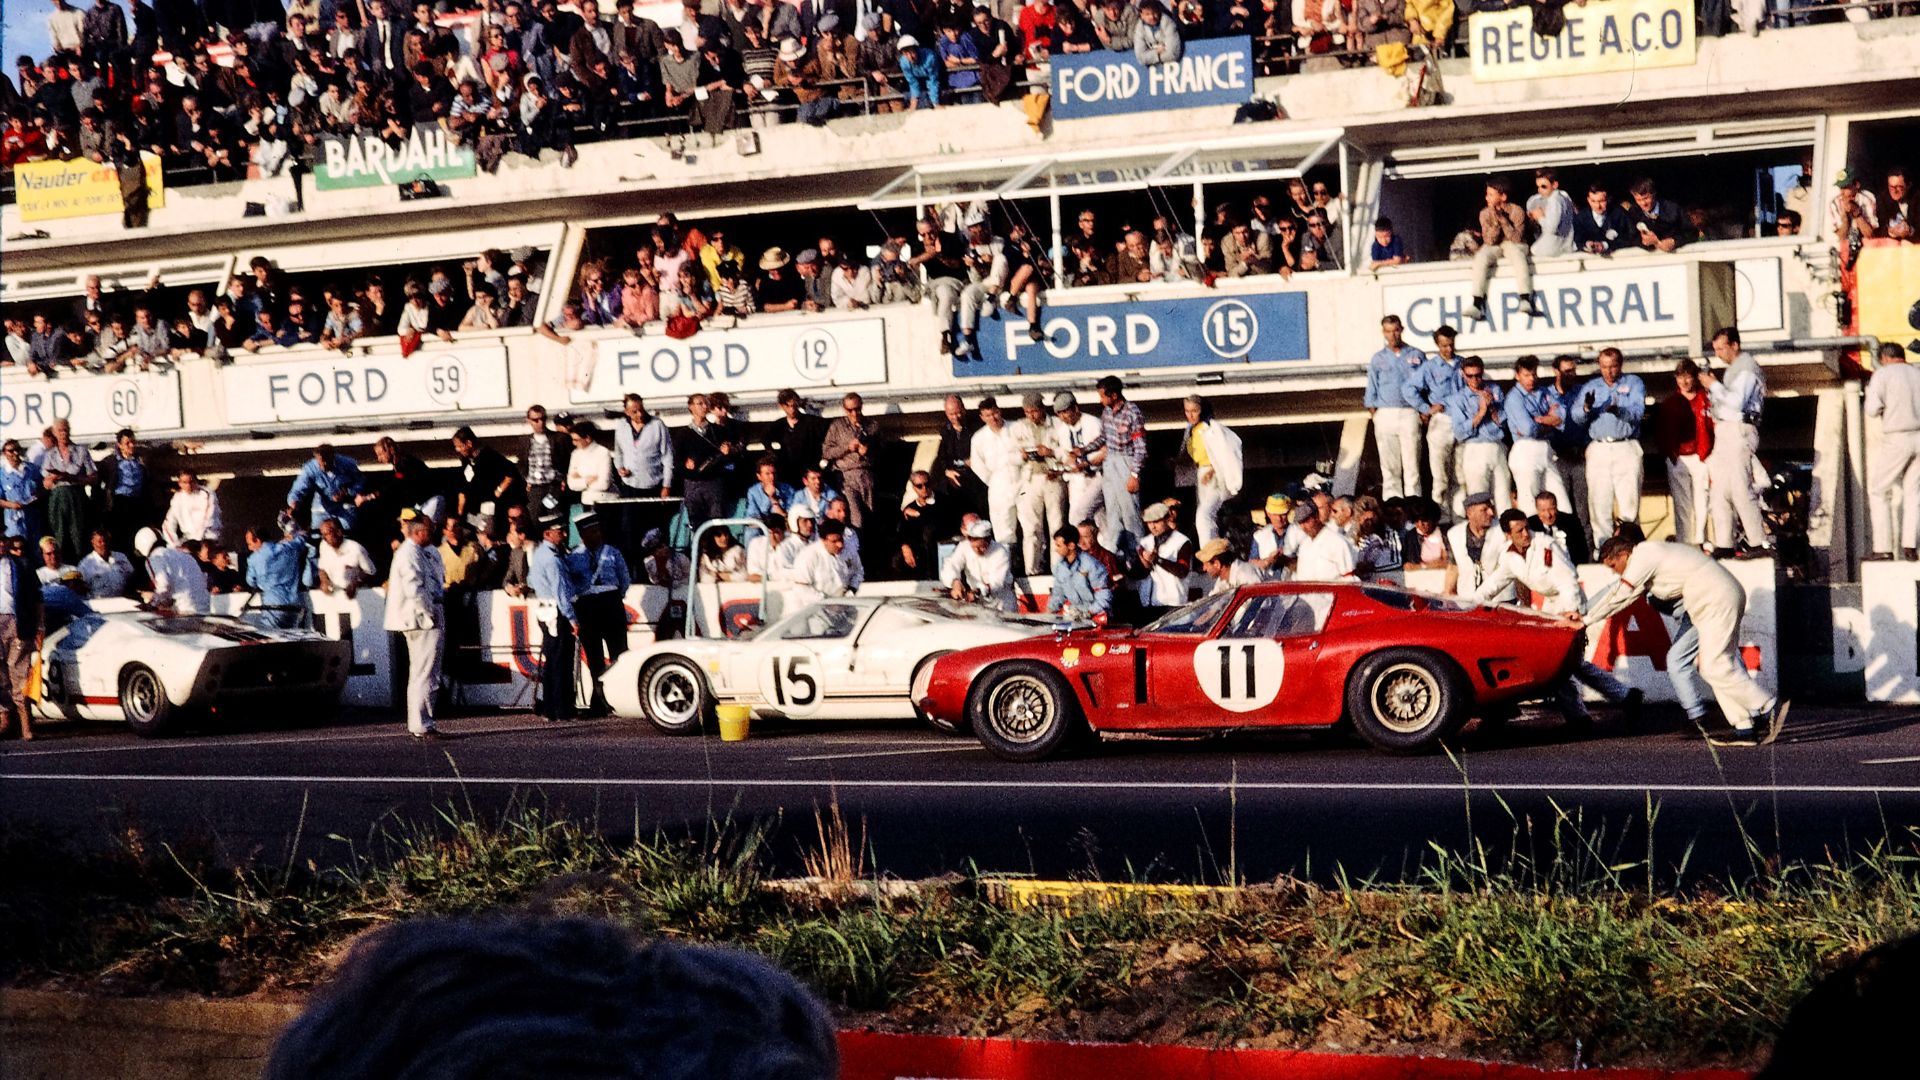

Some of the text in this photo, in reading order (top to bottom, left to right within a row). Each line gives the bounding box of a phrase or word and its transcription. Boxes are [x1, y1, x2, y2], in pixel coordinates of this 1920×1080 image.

[1058, 51, 1246, 104] FORD FRANCE
[20, 167, 88, 190] Nauder
[324, 125, 463, 184] BARDAHL
[1406, 281, 1674, 337] CHAPARRAL
[1004, 309, 1249, 361] FORD 15
[268, 365, 461, 408] FORD 59
[617, 339, 828, 386] FORD 12
[112, 389, 138, 416] 60
[772, 656, 817, 705] 15
[1217, 645, 1256, 698] 11
